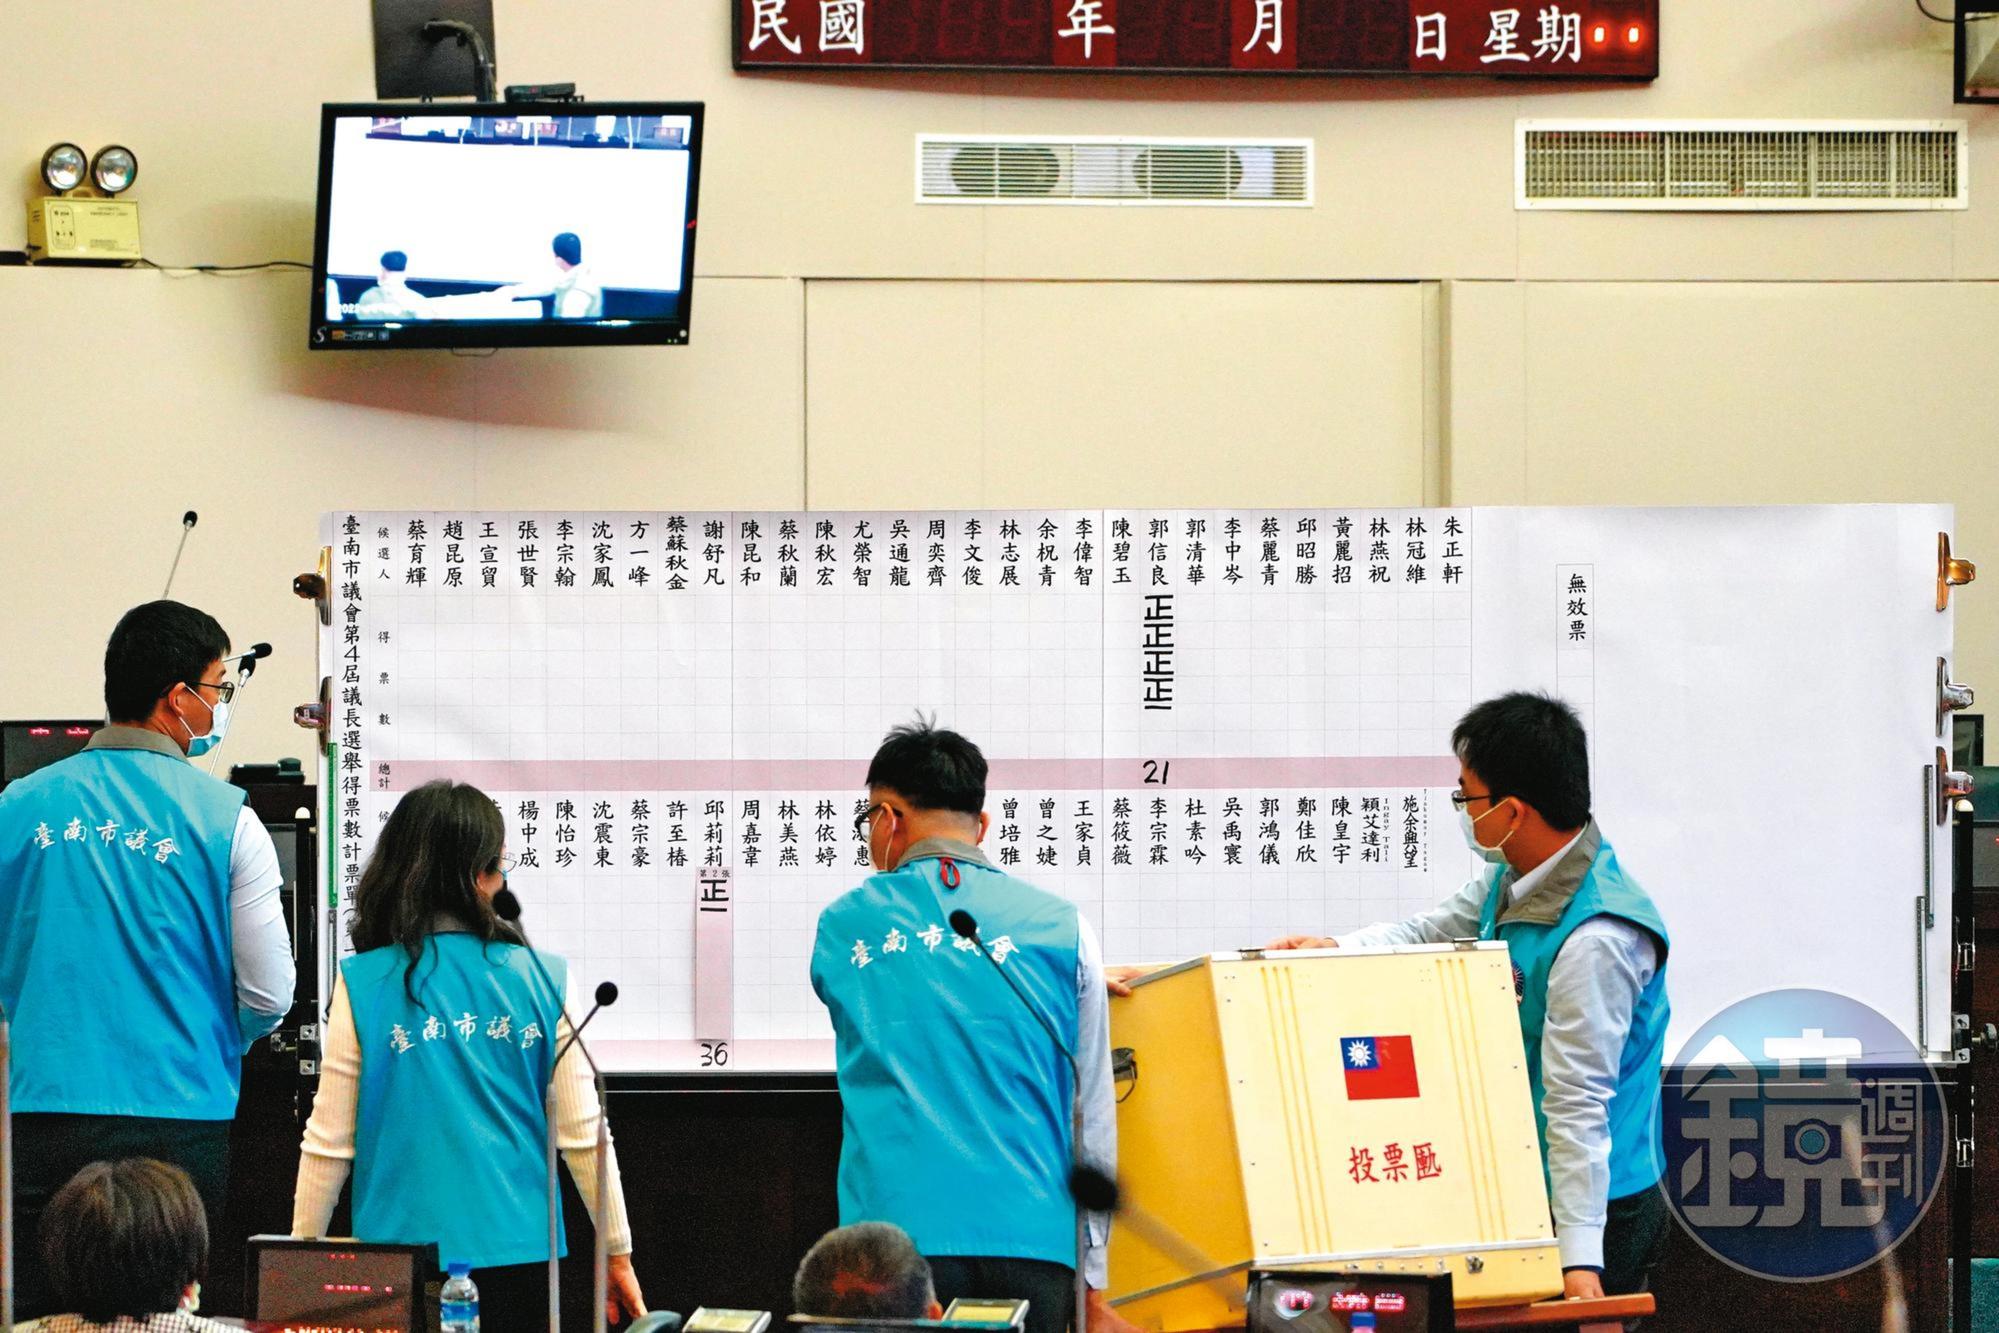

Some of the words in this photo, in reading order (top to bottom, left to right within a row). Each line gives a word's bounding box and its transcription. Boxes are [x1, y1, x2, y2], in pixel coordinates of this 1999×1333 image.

[748, 0, 864, 55] 民國
[1057, 0, 1117, 59] 年
[1242, 0, 1283, 54] 月
[1414, 11, 1447, 62] 日
[1479, 4, 1582, 64] 星期
[377, 527, 390, 579] 候選人
[405, 518, 428, 588] 蔡育輝
[442, 519, 465, 588] 趙昆原
[478, 521, 499, 588] 王宣貿
[516, 519, 540, 588] 張世賢
[554, 518, 577, 587] 李宗翰
[591, 520, 615, 588] 沈家鳳
[628, 520, 651, 587] 方一峰
[665, 515, 689, 590] 蔡蘇秋金
[702, 519, 725, 586] 謝舒凡
[740, 518, 763, 587] 陳昆和
[777, 518, 800, 588] 蔡秋蘭
[814, 518, 837, 586] 陳秋宏
[852, 519, 874, 587] 尤榮智
[888, 518, 911, 587] 吳通龍
[926, 519, 947, 587] 周奕齊
[962, 518, 984, 586] 李文俊
[999, 518, 1022, 586] 林志展
[1073, 517, 1094, 587] 李偉智
[1111, 517, 1133, 584] 陳碧玉
[1147, 518, 1169, 586] 郭信良
[1185, 518, 1207, 586] 郭清華
[1260, 516, 1281, 586] 蔡麗青
[1295, 517, 1318, 585] 邱昭勝
[1331, 516, 1353, 584] 黃麗招
[1368, 517, 1391, 583] 林燕祝
[1405, 516, 1428, 585] 林冠維
[1441, 515, 1464, 584] 朱正軒
[1567, 573, 1588, 642] 無效票
[378, 631, 391, 726] 得票數
[378, 763, 391, 789] 總計
[1142, 759, 1170, 785] 21
[32, 816, 182, 864] 臺南市議會
[518, 800, 540, 868] 楊中成
[555, 799, 578, 868] 陳怡珍
[592, 800, 615, 868] 沈震東
[630, 798, 651, 868] 蔡宗豪
[666, 799, 689, 867] 許至椿
[703, 799, 725, 867] 邱莉莉
[741, 799, 762, 868] 周嘉韋
[777, 799, 800, 867] 林美燕
[814, 799, 838, 868] 林依婷
[999, 797, 1022, 866] 曾培雅
[1035, 797, 1058, 867] 曾之婕
[1074, 800, 1095, 866] 王家貞
[1111, 797, 1133, 866] 蔡筱薇
[1149, 796, 1169, 866] 李宗霖
[1184, 797, 1207, 865] 杜素吟
[1258, 797, 1280, 865] 郭鴻儀
[1295, 796, 1318, 863] 鄭佳欣
[1331, 795, 1353, 865] 陳皇宇
[1402, 794, 1420, 869] 施余興望
[390, 1012, 544, 1054] 臺南市議會
[700, 1041, 728, 1067] 36
